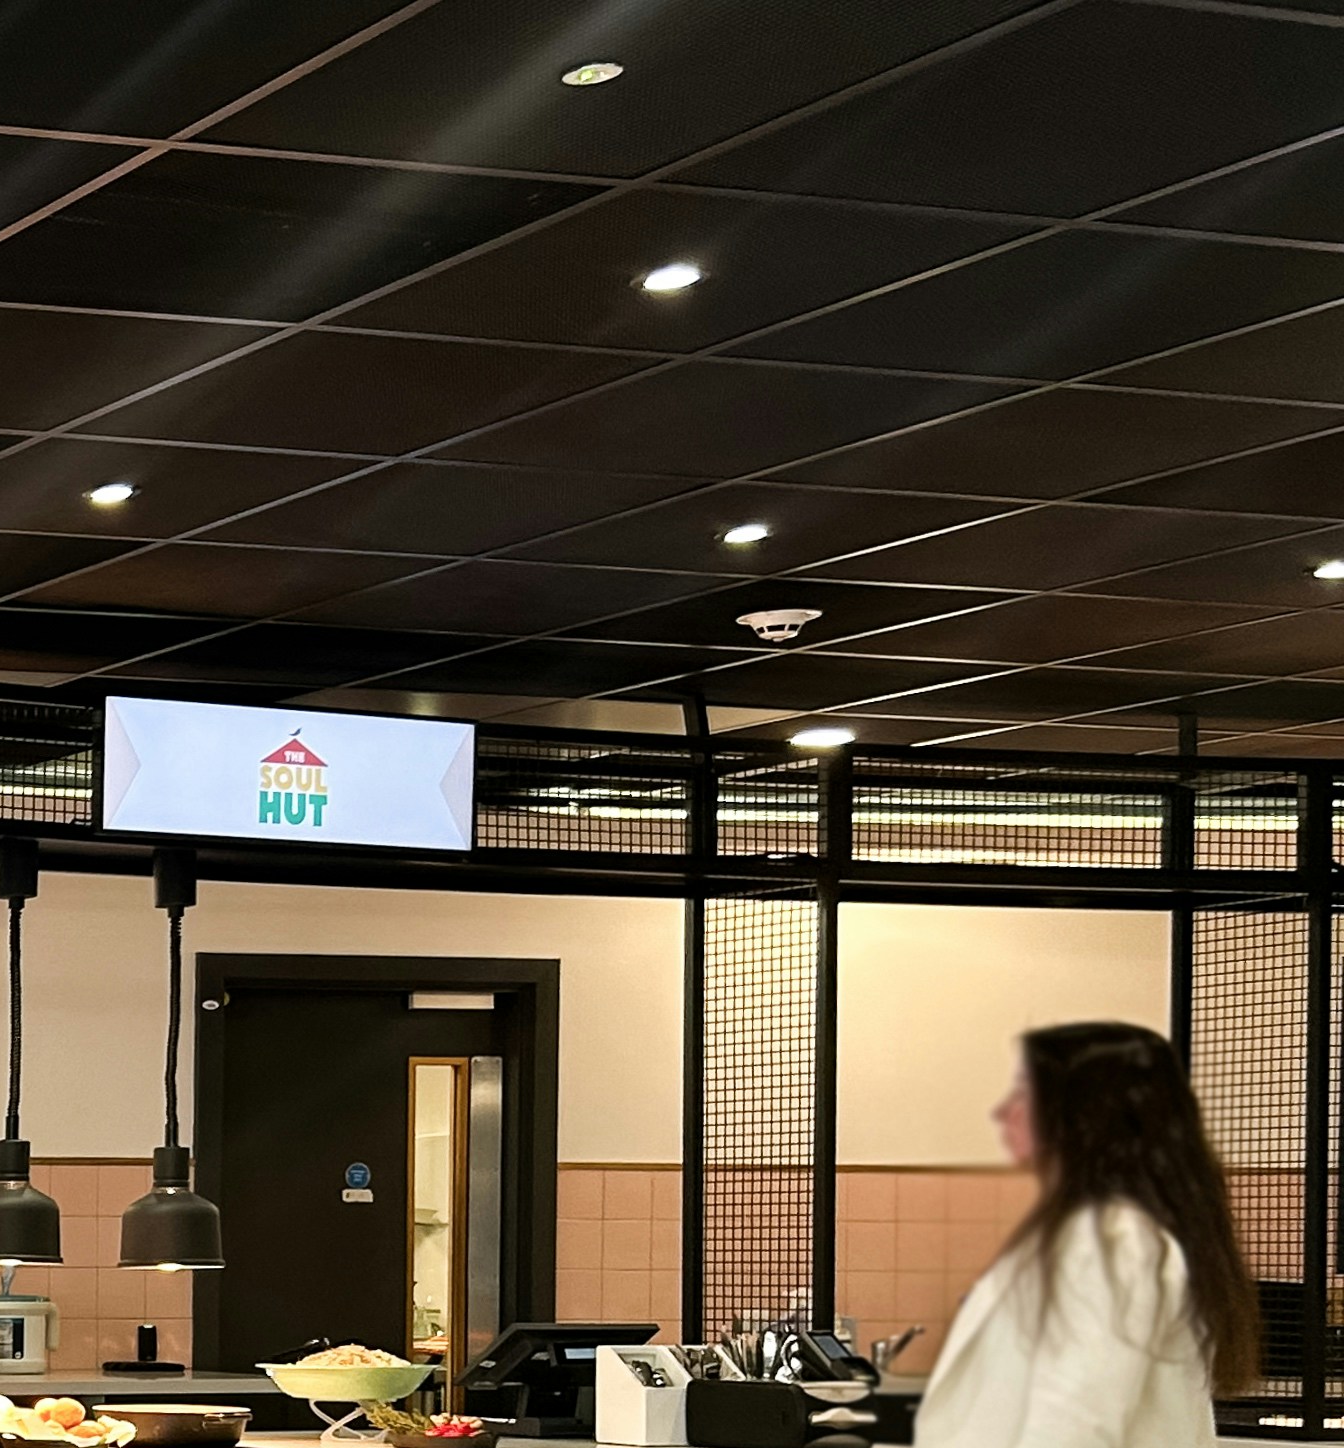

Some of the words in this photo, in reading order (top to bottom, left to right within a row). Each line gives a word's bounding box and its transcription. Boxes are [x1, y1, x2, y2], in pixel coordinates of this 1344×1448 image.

[284, 750, 305, 764] THE
[260, 764, 327, 793] SOUL
[259, 790, 328, 827] HUT
